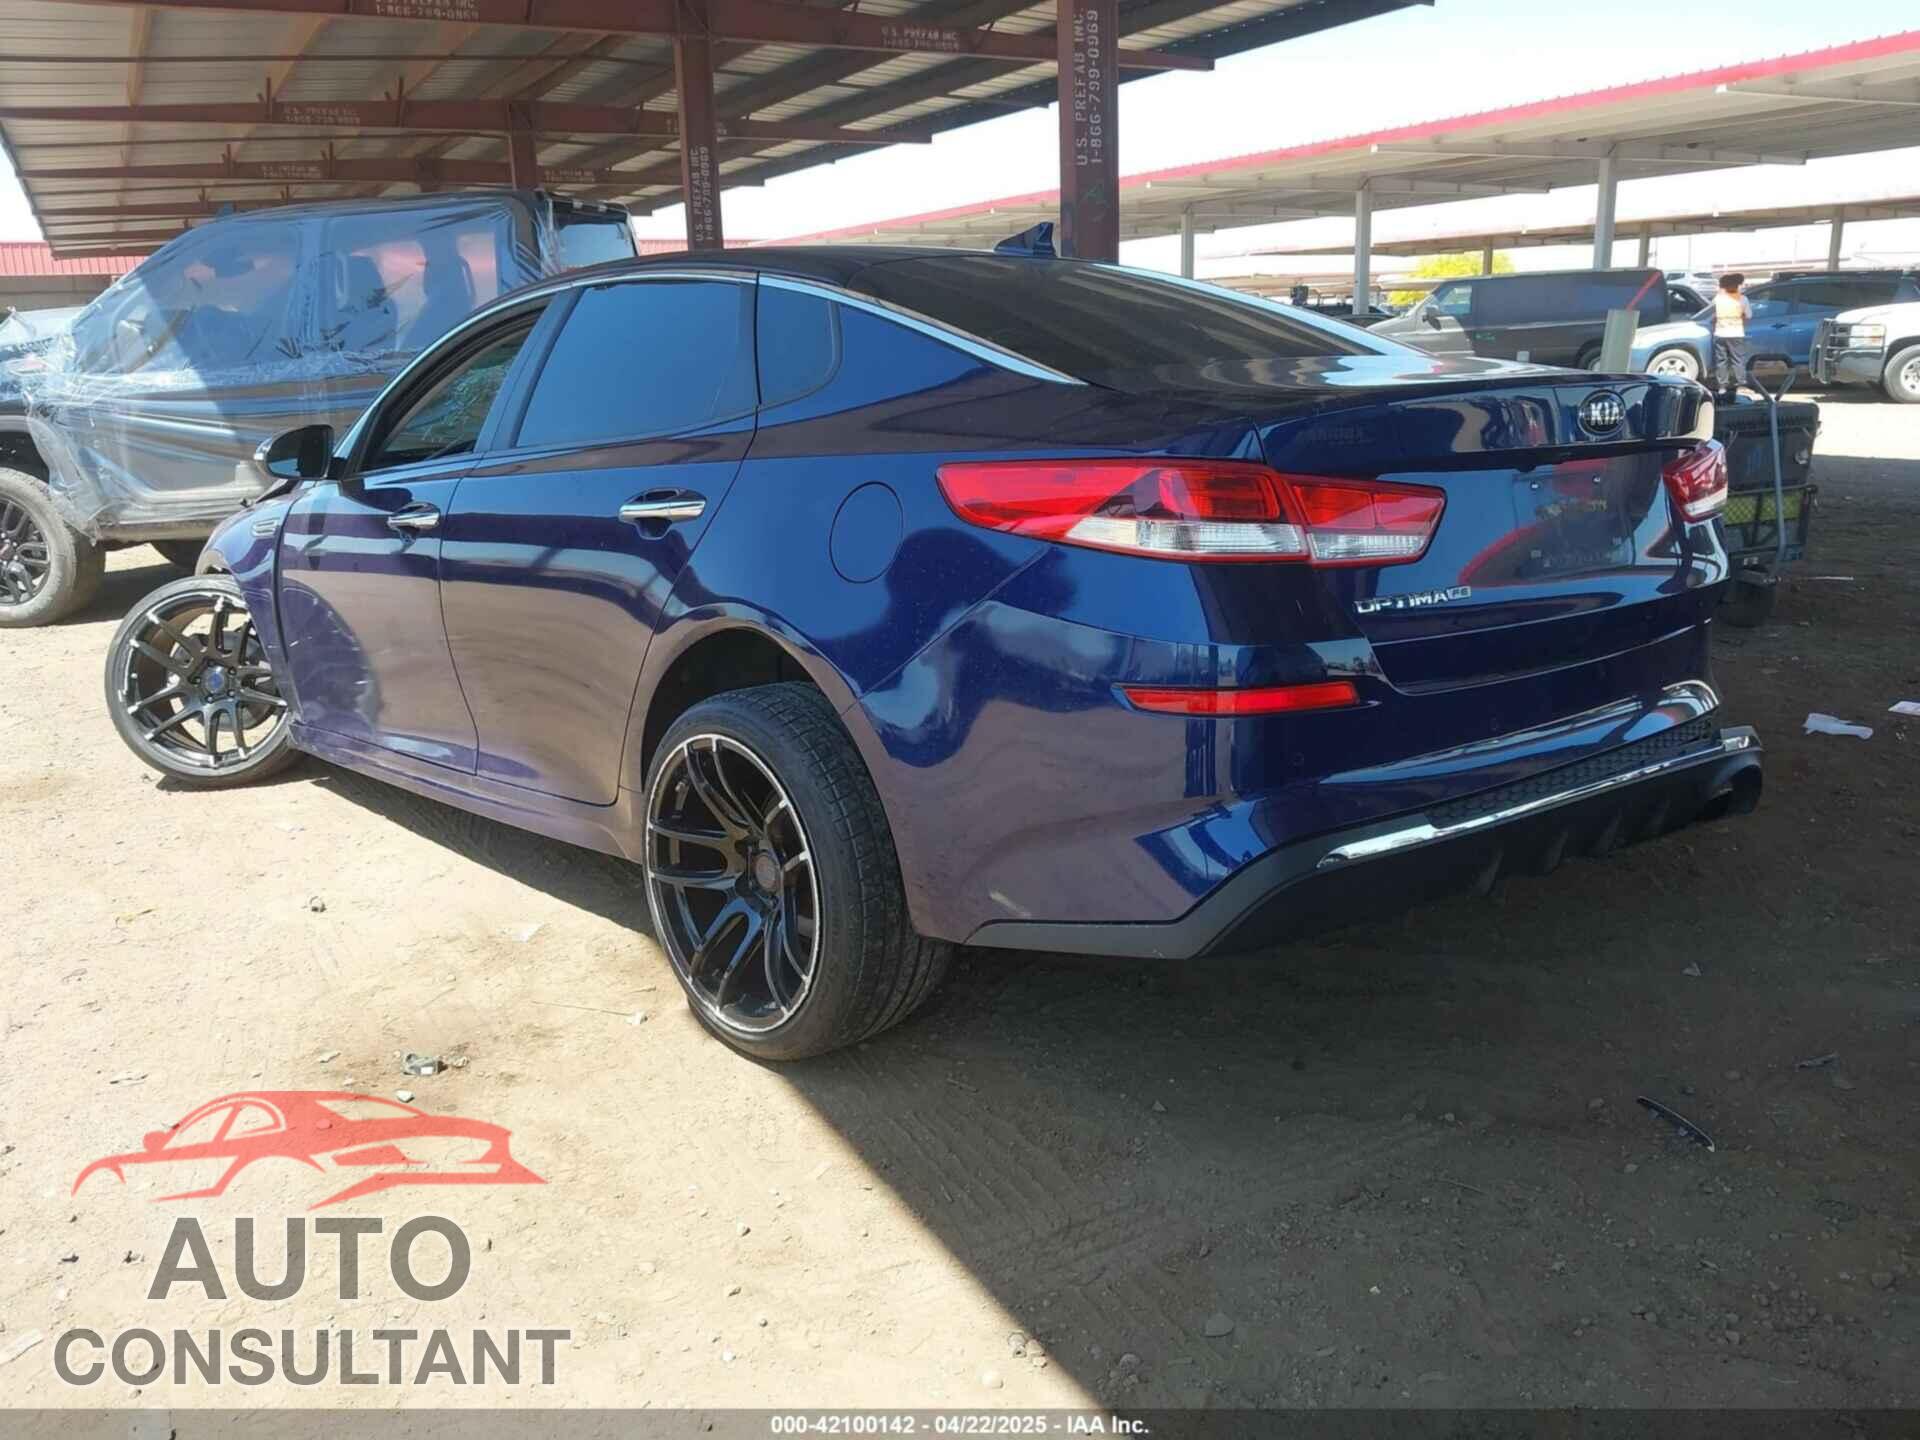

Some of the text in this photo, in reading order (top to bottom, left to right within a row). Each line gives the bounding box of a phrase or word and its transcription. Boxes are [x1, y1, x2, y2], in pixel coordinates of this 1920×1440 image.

[1074, 52, 1087, 122] PREFAB
[1087, 9, 1103, 163] 1-866-799-0969
[1590, 402, 1619, 425] KIA
[1355, 590, 1449, 613] OPTIMA
